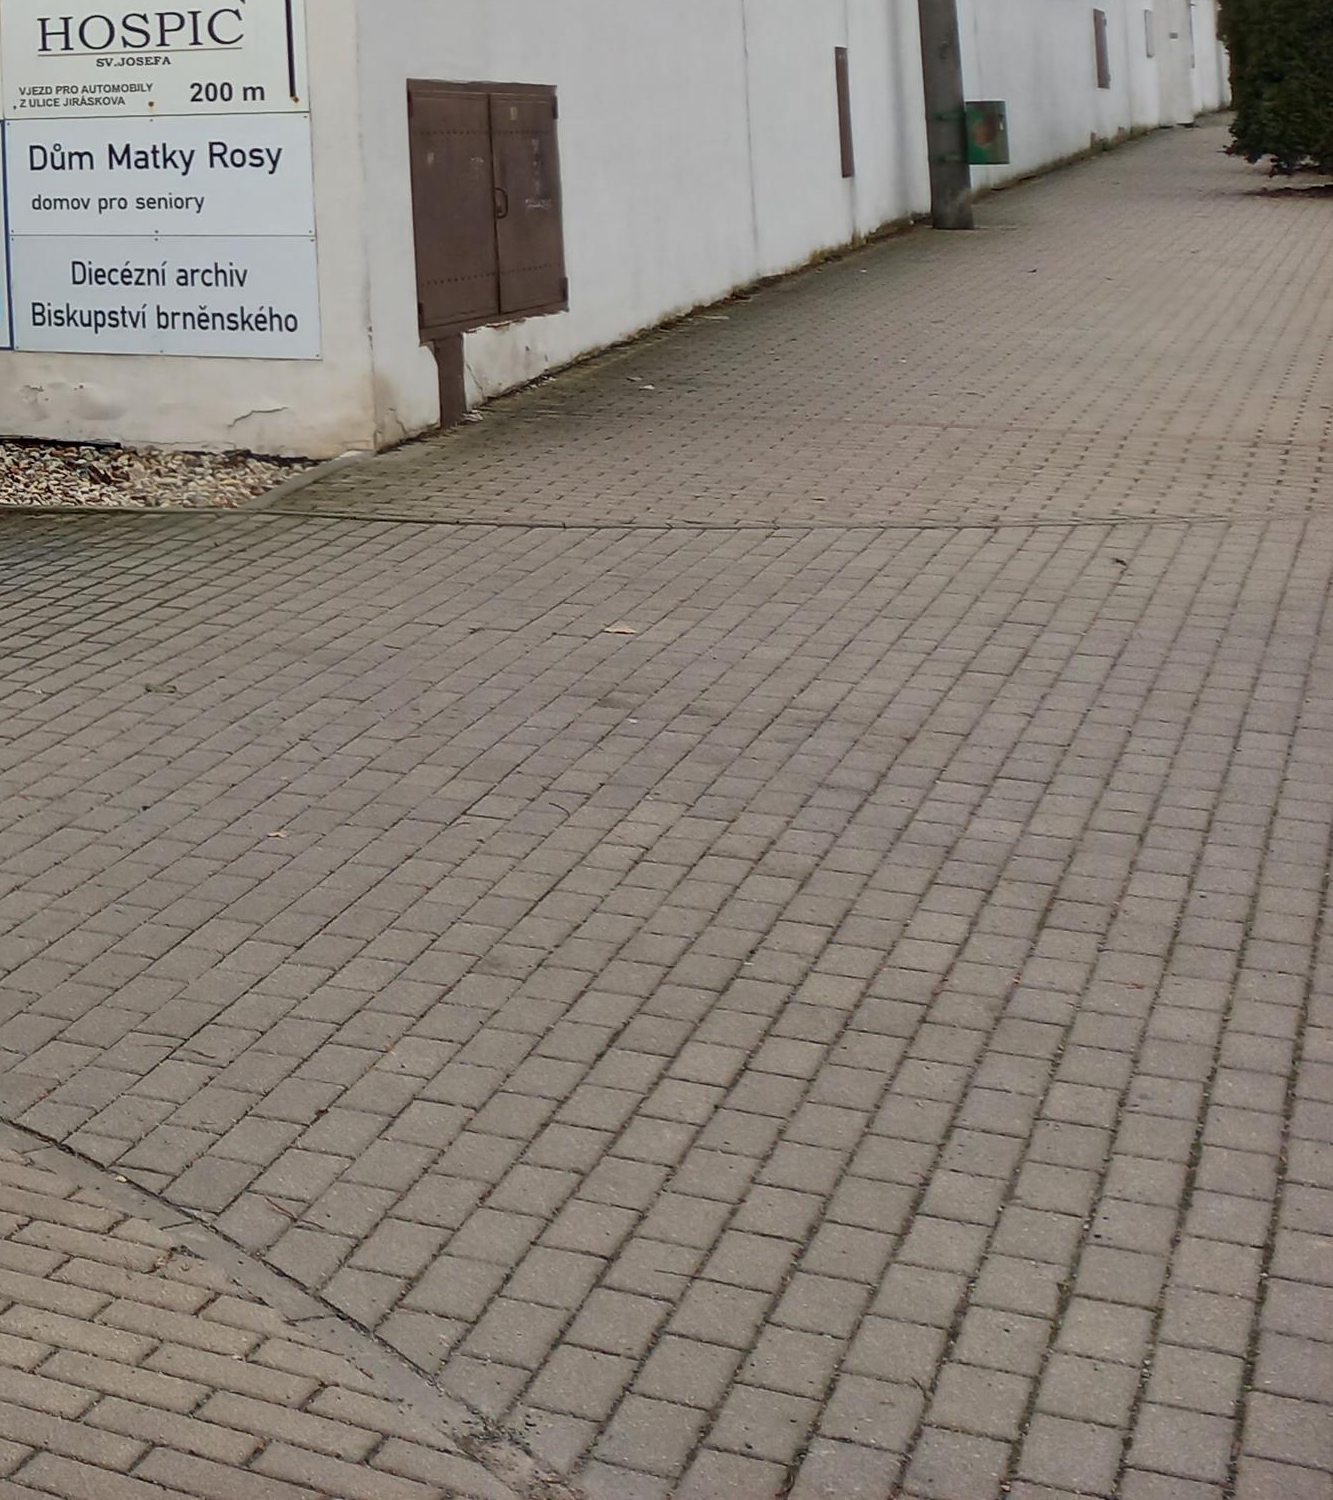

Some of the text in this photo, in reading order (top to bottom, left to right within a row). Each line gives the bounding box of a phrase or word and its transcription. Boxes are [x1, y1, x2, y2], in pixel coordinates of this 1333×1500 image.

[37, 8, 245, 52] HOSPIC
[19, 83, 153, 95] VJEZD PRO AUTOMOBILY
[190, 82, 265, 102] 200 m
[19, 95, 125, 108] Z ULICE JIRÁSKOVA
[29, 141, 282, 176] Dům Matky Rosy
[31, 192, 205, 214] domov pro seniory
[71, 260, 248, 287] Diecézní archiv
[31, 302, 298, 334] Biskupství brněnského
